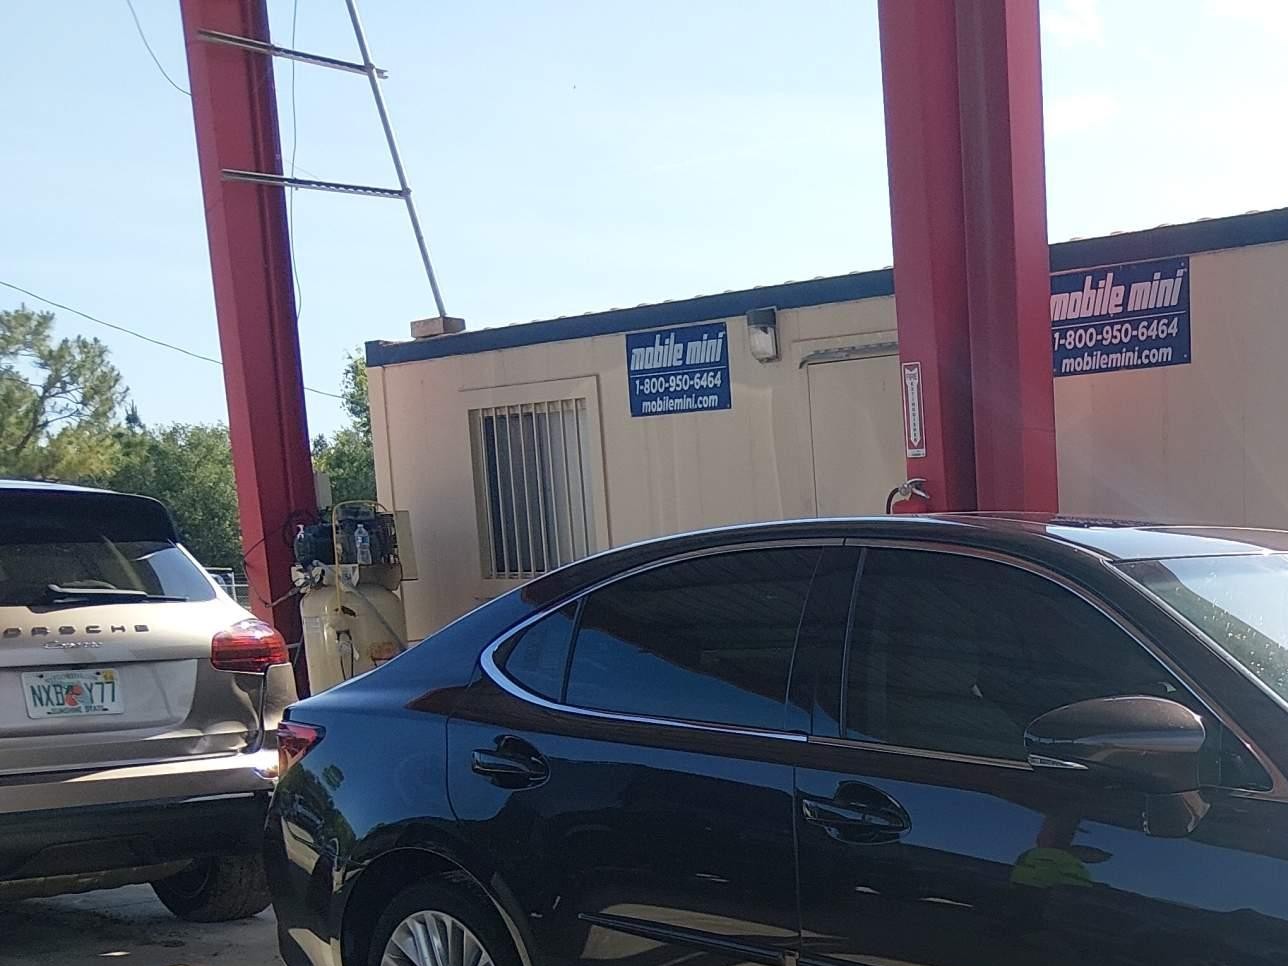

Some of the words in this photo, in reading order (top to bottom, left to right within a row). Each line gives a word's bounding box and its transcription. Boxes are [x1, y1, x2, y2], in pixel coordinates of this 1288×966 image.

[1050, 272, 1125, 322] mobile
[1127, 269, 1184, 312] mini
[1053, 316, 1179, 351] 1-800-950-6464
[630, 332, 684, 371] mobile
[685, 331, 726, 365] mini
[1061, 346, 1173, 373] mobilemini.com
[634, 371, 722, 395] 1-800-950-6464
[641, 394, 719, 413] mobilemini.com
[83, 681, 116, 705] Y77
